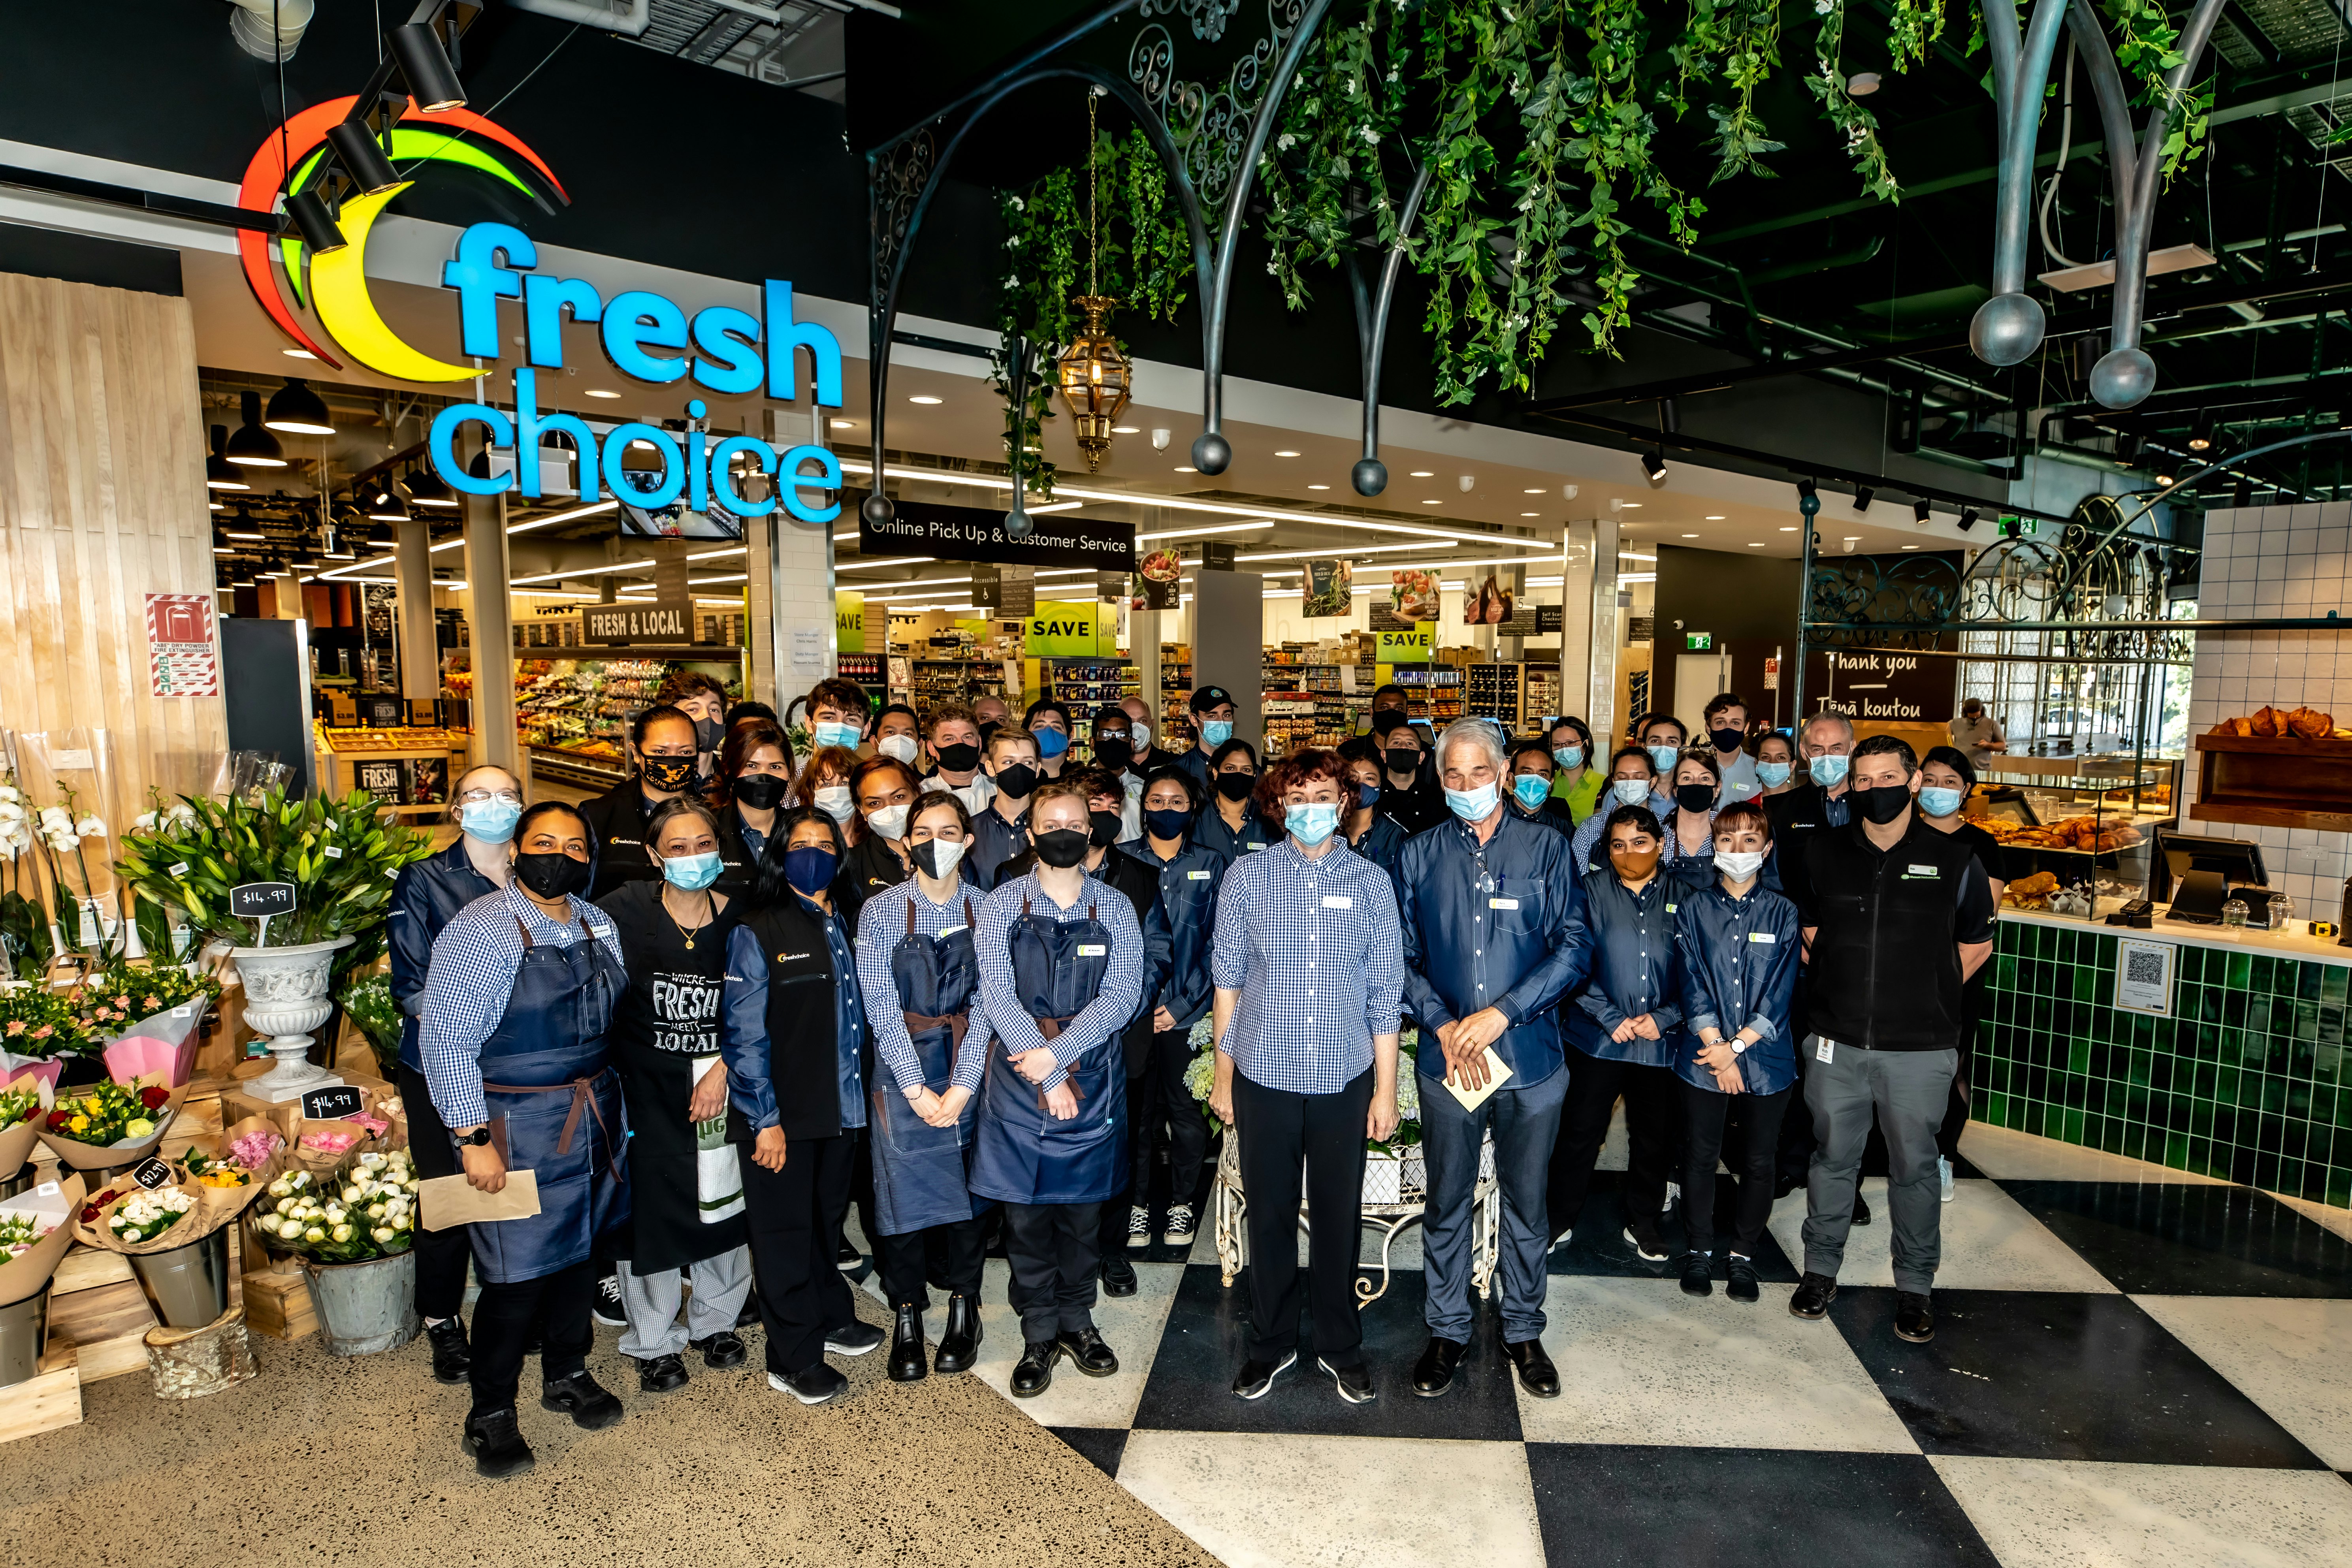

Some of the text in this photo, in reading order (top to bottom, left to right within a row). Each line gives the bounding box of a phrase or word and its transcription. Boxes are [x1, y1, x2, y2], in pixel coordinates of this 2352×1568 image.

[443, 222, 843, 408] fresh
[429, 367, 843, 523] choice
[871, 518, 1126, 552] Online Pick Up & Customer Service
[1011, 564, 1016, 579] 2
[1518, 598, 1523, 608] 5
[1650, 606, 1654, 616] 6
[591, 613, 627, 636] FRESH
[631, 612, 639, 636] &
[642, 610, 684, 635] LOCAL
[836, 613, 861, 630] SAVE
[1033, 621, 1089, 636] SAVE
[1100, 623, 1115, 638] SAVE
[1383, 634, 1428, 646] SAVE
[1825, 652, 1916, 678] Thank you
[375, 706, 396, 717] FRESH
[1817, 696, 1920, 717] Tēnā koutou
[362, 768, 398, 788] FRESH
[242, 890, 286, 904] $14.99
[672, 972, 705, 985] WHERE
[653, 981, 720, 1020] FRESH
[670, 1020, 700, 1032] MEETS
[654, 1031, 719, 1052] LOCAL
[311, 1095, 351, 1118] $14.99
[141, 1163, 166, 1184] $12.99
